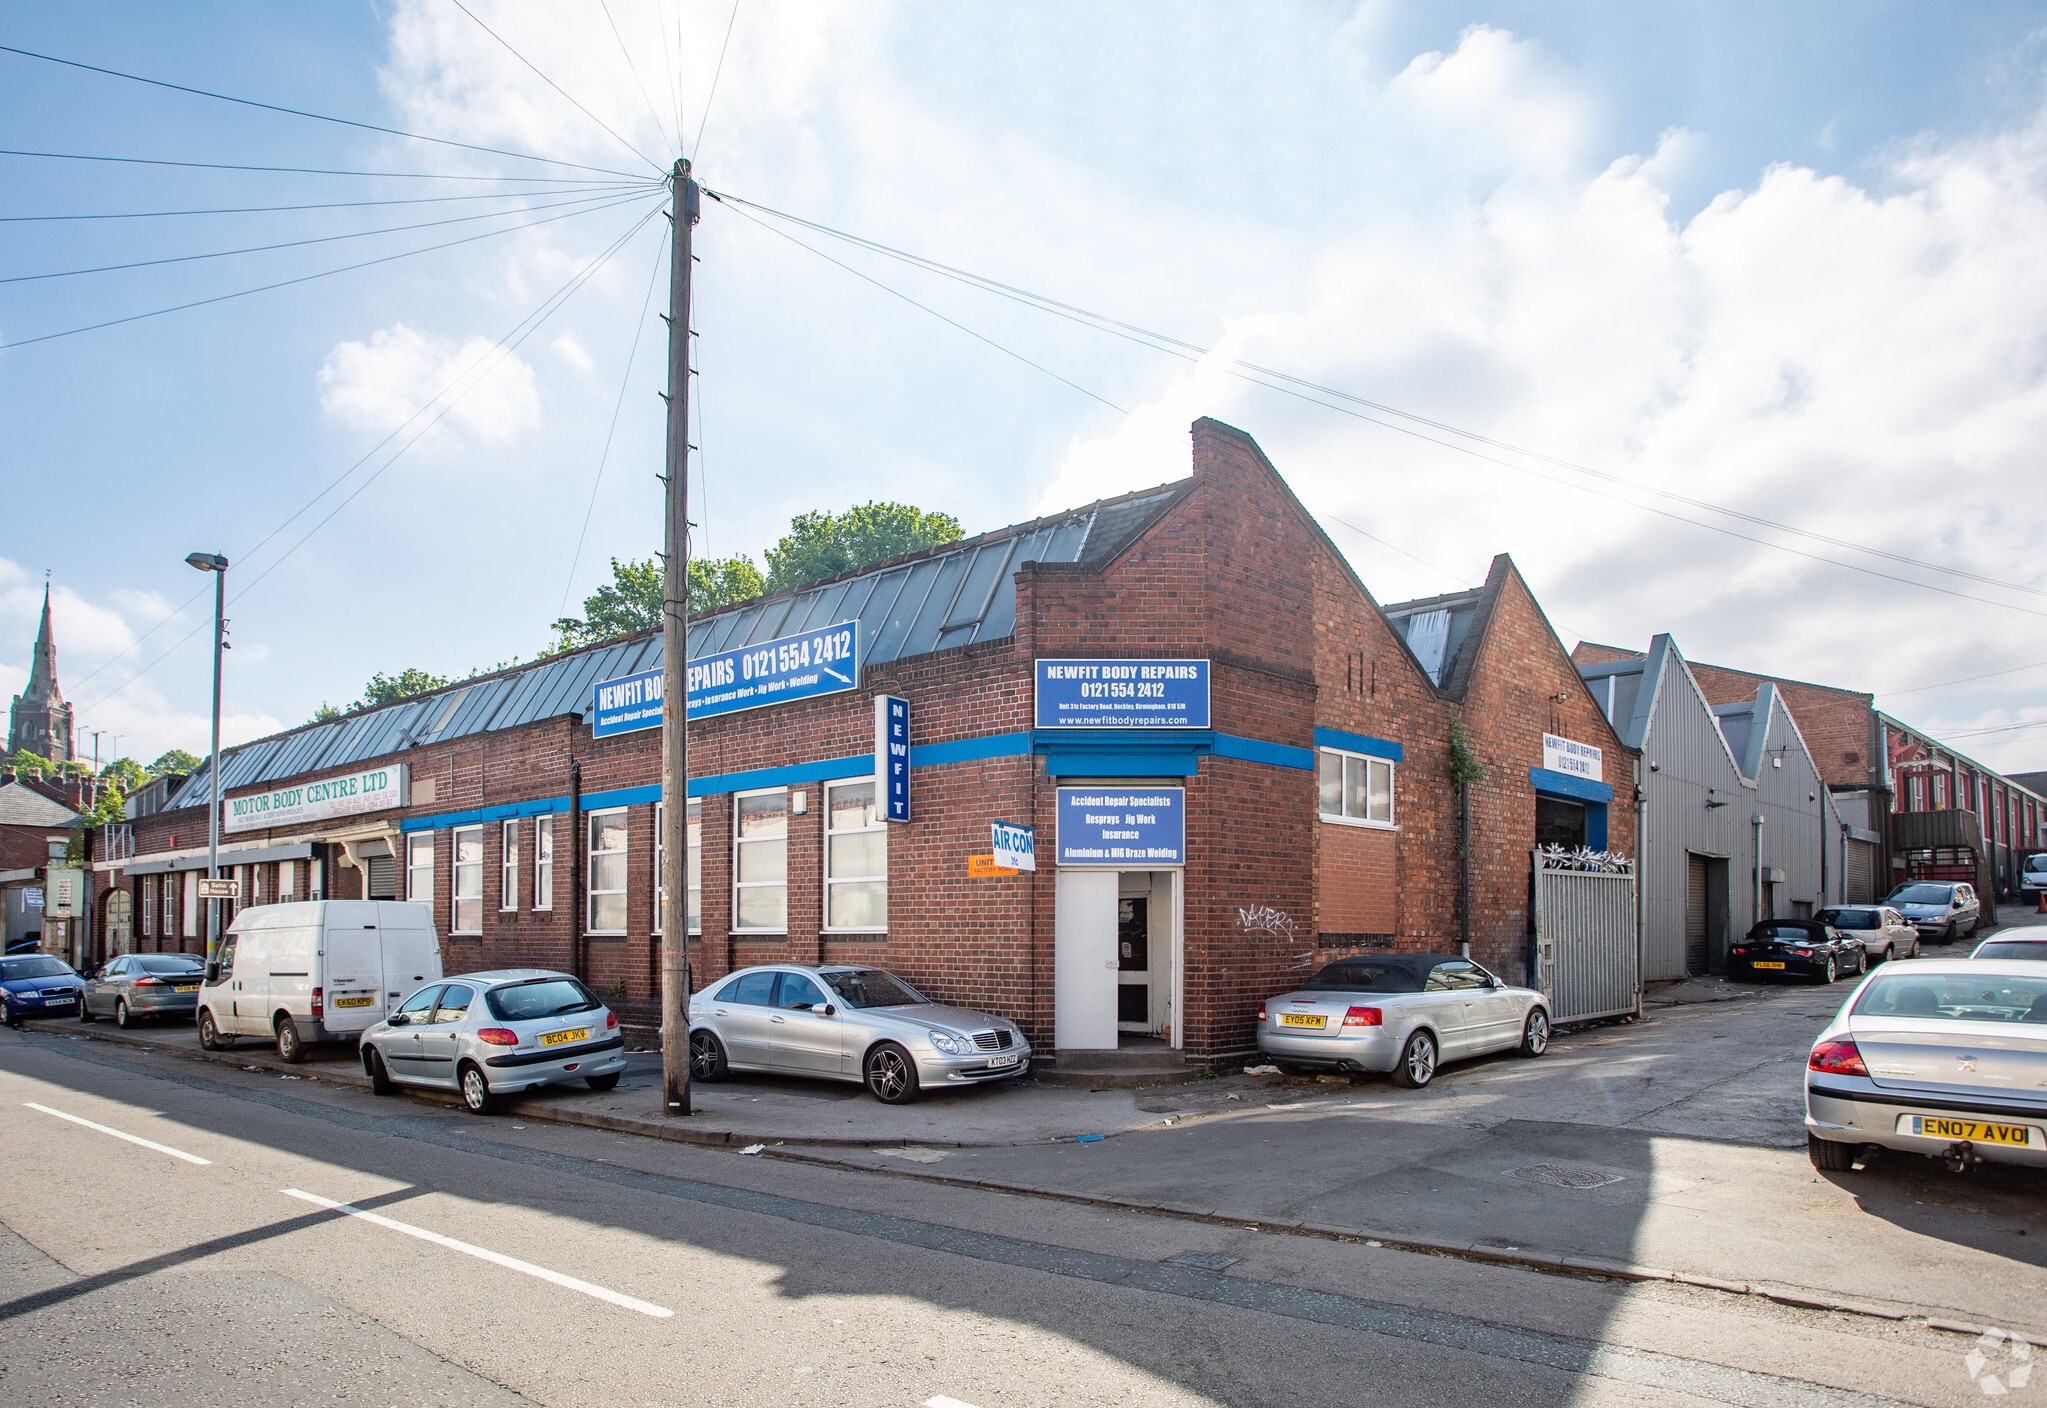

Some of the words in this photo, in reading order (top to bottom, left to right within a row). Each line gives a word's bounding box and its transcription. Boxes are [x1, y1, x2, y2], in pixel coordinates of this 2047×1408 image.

[599, 679, 642, 711] NEWFIT
[687, 658, 735, 693] EPAIRS
[743, 648, 776, 680] 0121
[779, 640, 810, 671] 554
[813, 630, 851, 663] 2412
[1047, 666, 1099, 680] NEWFIT
[1102, 666, 1138, 679] BODY
[1141, 666, 1198, 680] REPAIRS
[1081, 682, 1109, 698] 0121
[1111, 682, 1135, 698] 554
[1137, 682, 1165, 698] 2412
[600, 713, 624, 726] Accident
[624, 710, 642, 723] Repair
[705, 691, 736, 705] Insurance
[737, 686, 754, 698] Work
[757, 683, 767, 695] Jig
[768, 681, 786, 694] Work
[789, 674, 818, 688] Welding
[1080, 703, 1099, 711] Factory
[1059, 715, 1188, 726] www.newfitbodyrepairs.com
[1545, 736, 1565, 751] NEWFIT
[1566, 742, 1580, 755] BODY
[1580, 746, 1600, 761] REPAIRS
[890, 704, 907, 814] NEWFIT
[233, 795, 270, 816] MOTOR
[273, 788, 304, 809] BODY
[307, 777, 358, 803] CENTRE
[363, 771, 387, 793] LTD
[1071, 796, 1104, 807] Accident
[1105, 796, 1129, 808] Repair
[1129, 796, 1171, 807] Specialists
[1085, 814, 1119, 825] Resprays
[1125, 814, 1135, 825] Jig
[1136, 814, 1156, 824] Work
[993, 828, 1011, 851] AIR
[1013, 832, 1034, 855] CON
[1102, 829, 1139, 840] Insurance
[1064, 847, 1104, 858] Aluminium
[1104, 848, 1110, 858] &
[1111, 848, 1125, 858] MIG
[1125, 848, 1146, 858] Braze
[1147, 847, 1177, 859] Welding
[976, 858, 994, 866] UNIT
[1286, 1015, 1304, 1024] EY05
[1305, 1016, 1321, 1025] XFM
[546, 1033, 569, 1044] BC04
[571, 1029, 587, 1040] JKV
[991, 1056, 1006, 1066] KT03
[1007, 1054, 1016, 1064] HZZ
[1924, 1119, 1976, 1137] EN07
